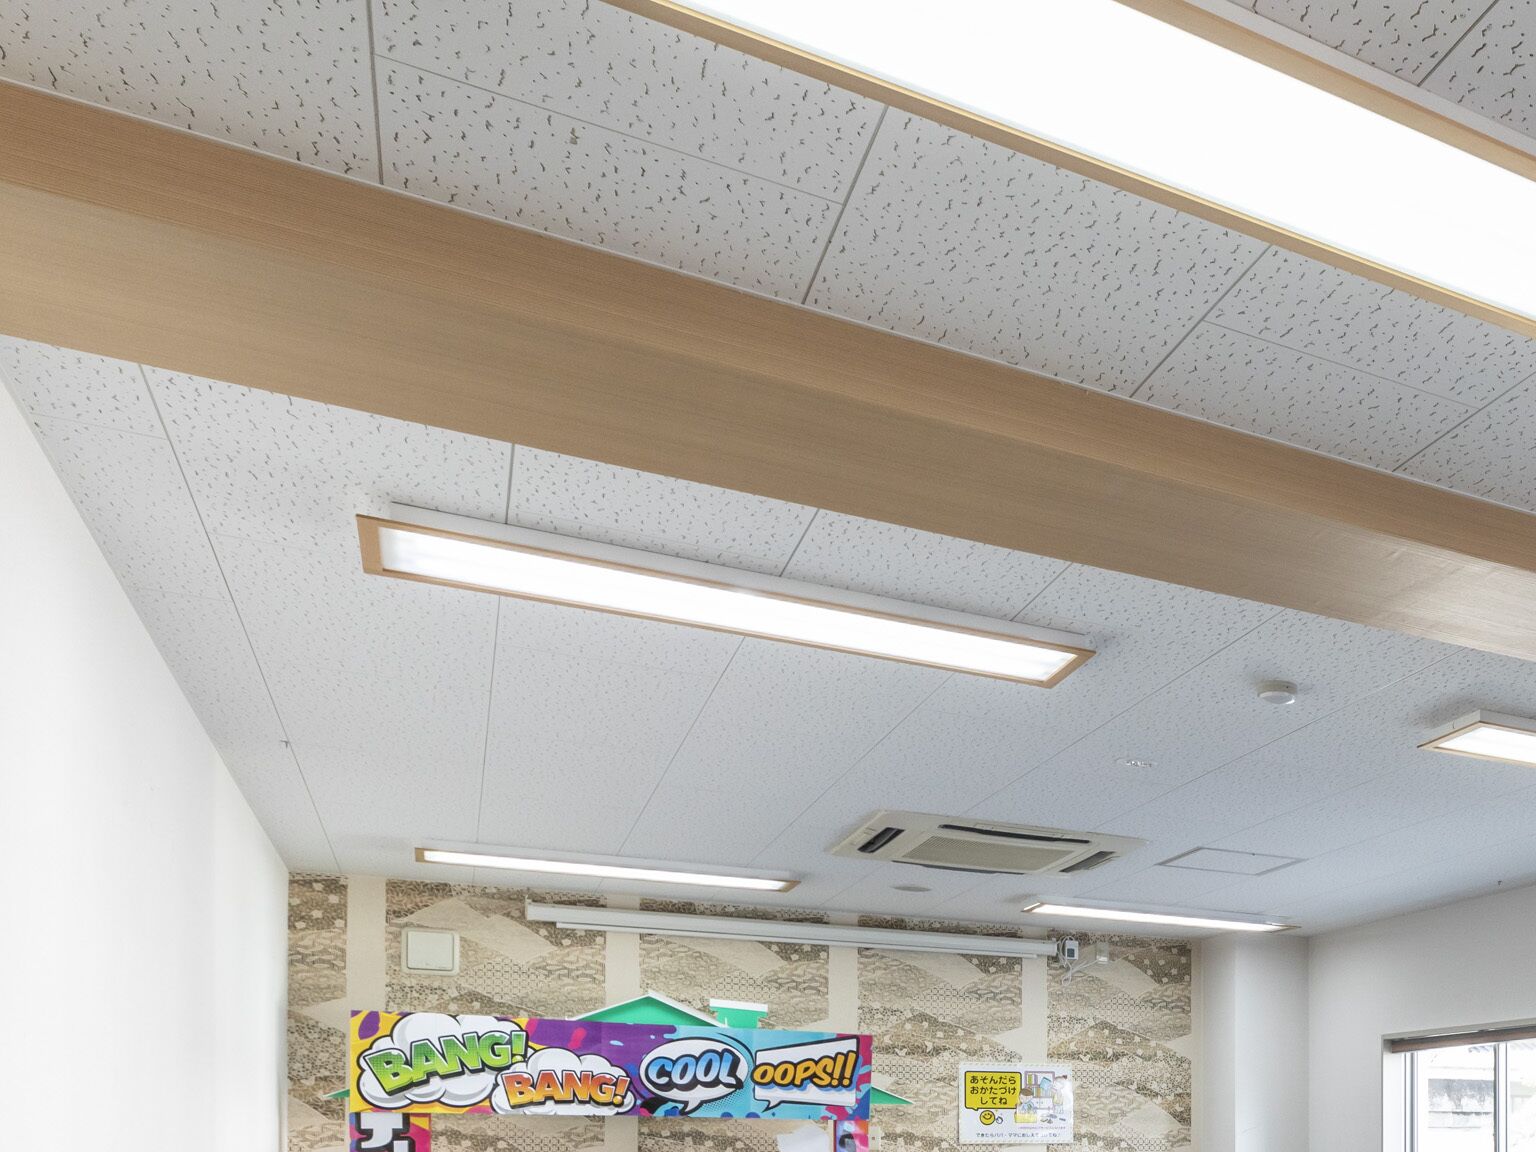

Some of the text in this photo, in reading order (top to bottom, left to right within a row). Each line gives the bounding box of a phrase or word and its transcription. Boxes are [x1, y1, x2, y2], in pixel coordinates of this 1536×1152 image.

[364, 1030, 527, 1096] BANG!
[645, 1049, 743, 1091] COOL
[752, 1050, 859, 1089] OOPS!!
[970, 1076, 1017, 1085] あそんだら
[501, 1070, 631, 1108] BANG!
[970, 1086, 1017, 1095] おかたづけ
[980, 1097, 1008, 1105] してね
